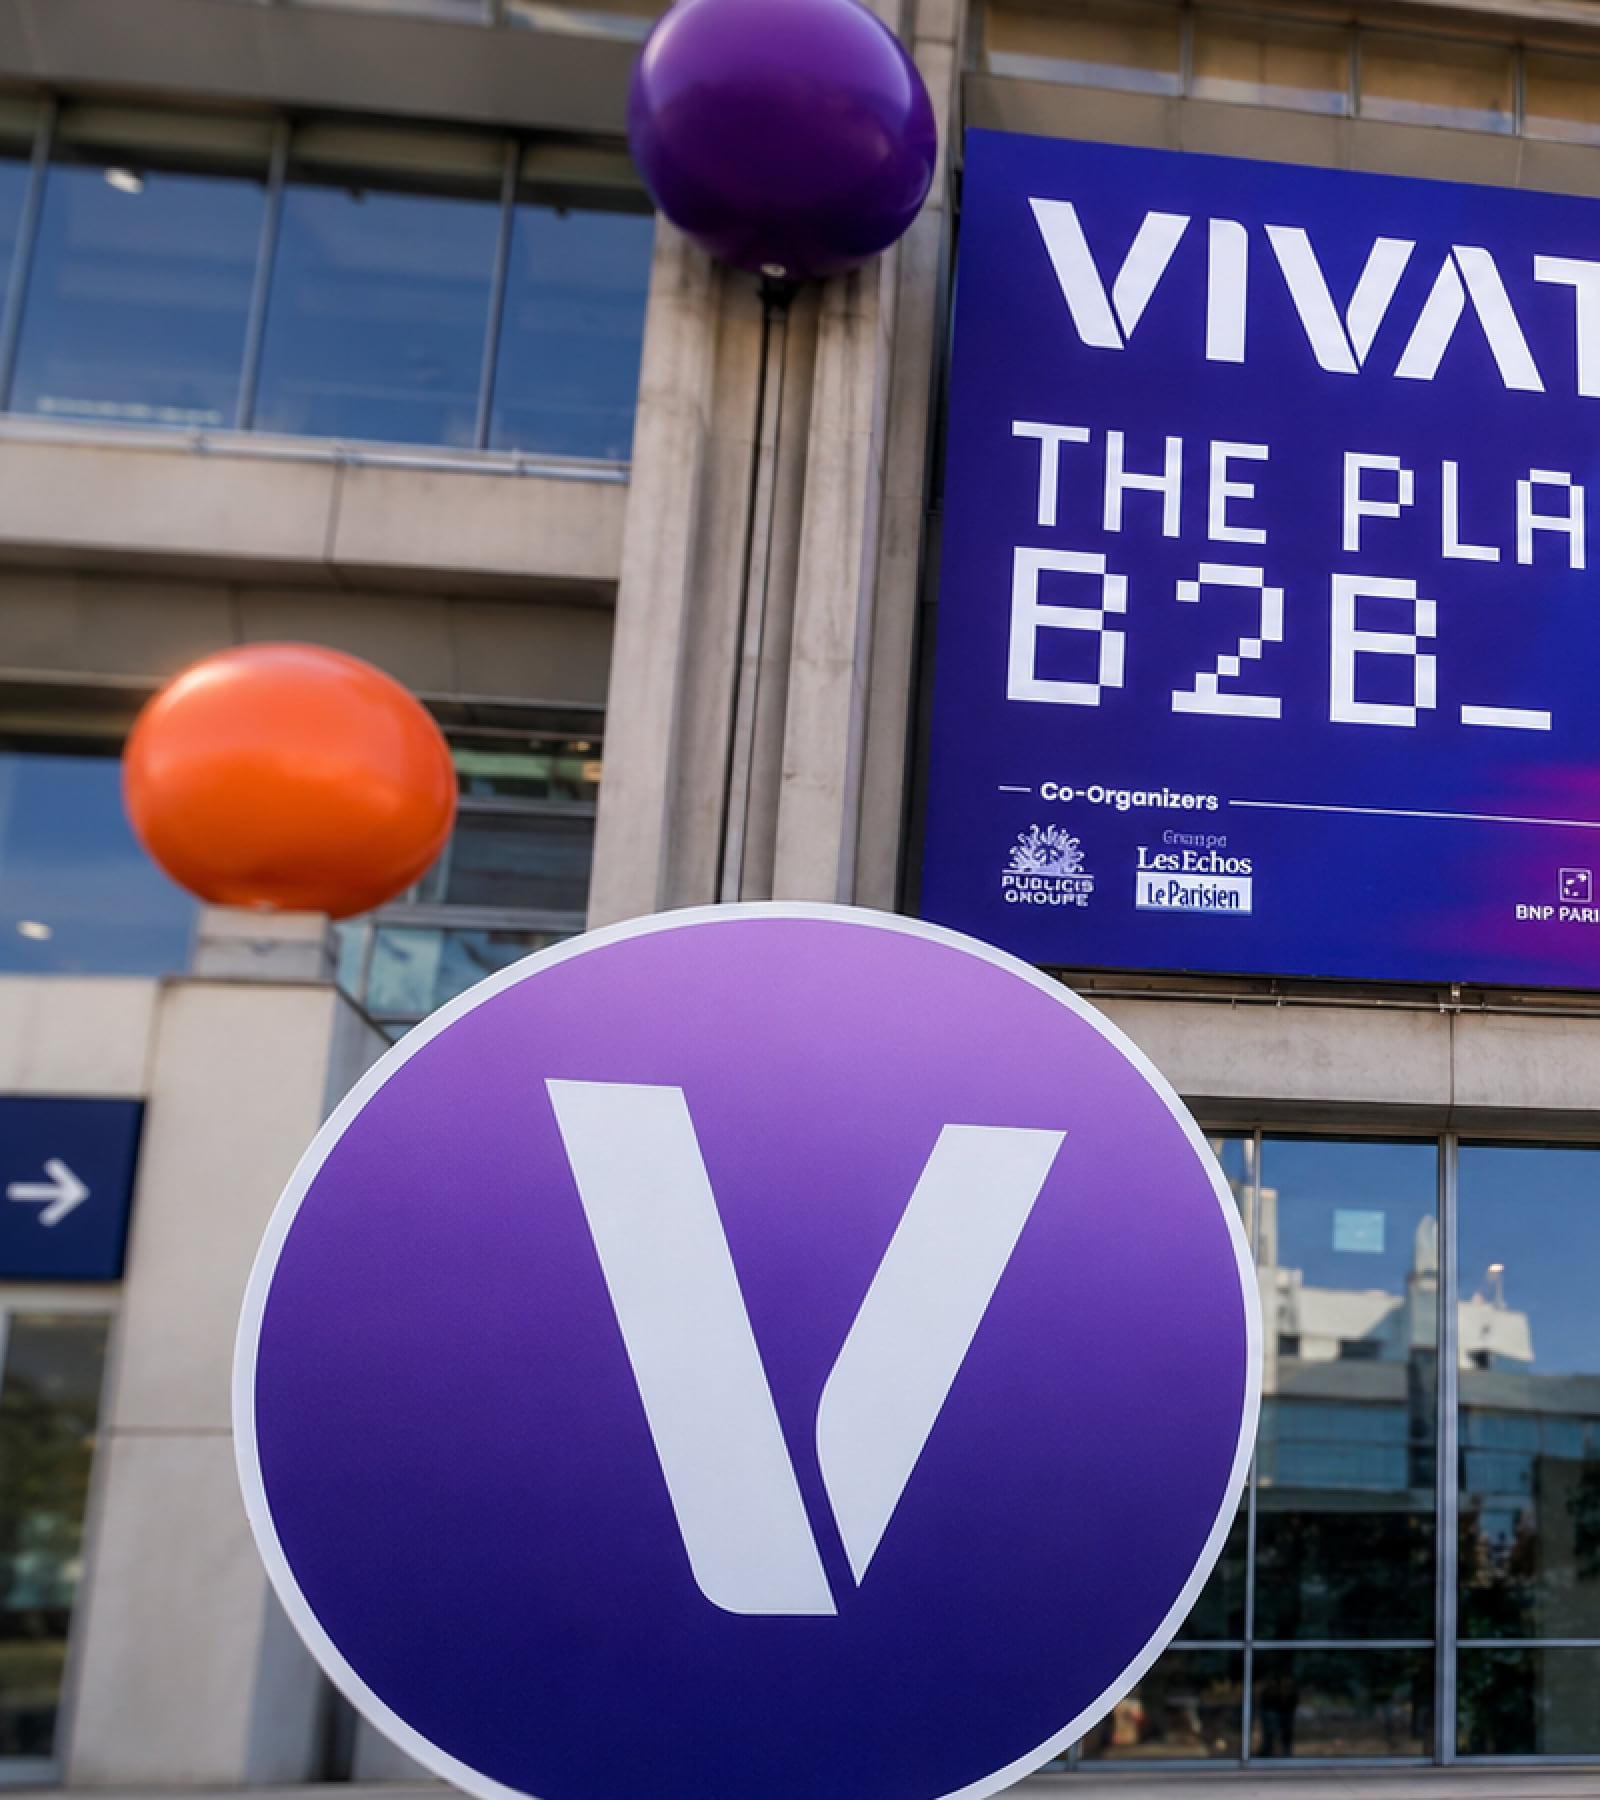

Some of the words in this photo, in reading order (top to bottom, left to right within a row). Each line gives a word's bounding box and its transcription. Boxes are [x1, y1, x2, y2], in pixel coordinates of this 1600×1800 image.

[1012, 421, 1269, 545] THE
[1040, 781, 1219, 811] Co-Organizers
[1136, 845, 1179, 870] Les
[1182, 849, 1252, 874] Echos
[1168, 879, 1240, 909] Parisien
[1515, 903, 1554, 921] BNP
